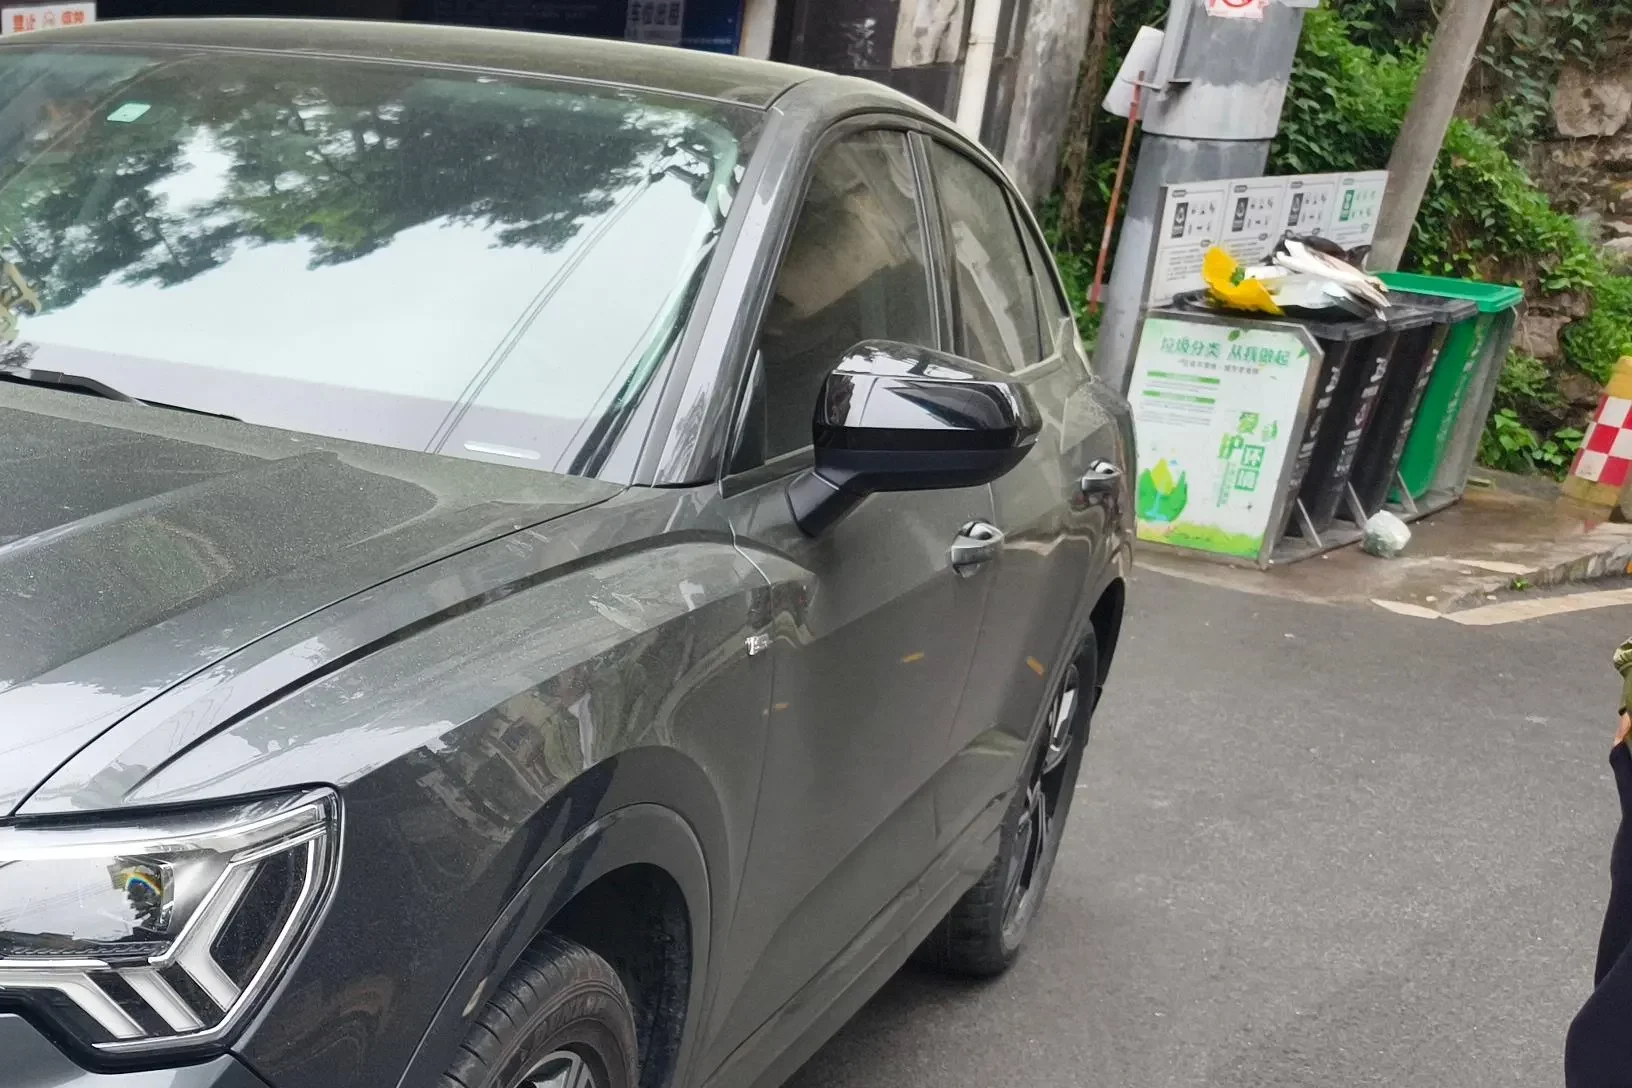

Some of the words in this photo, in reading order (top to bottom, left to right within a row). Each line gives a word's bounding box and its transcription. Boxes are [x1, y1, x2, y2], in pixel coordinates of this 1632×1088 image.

[1161, 336, 1221, 359] 垃圾分类
[1227, 344, 1290, 366] 从我做起
